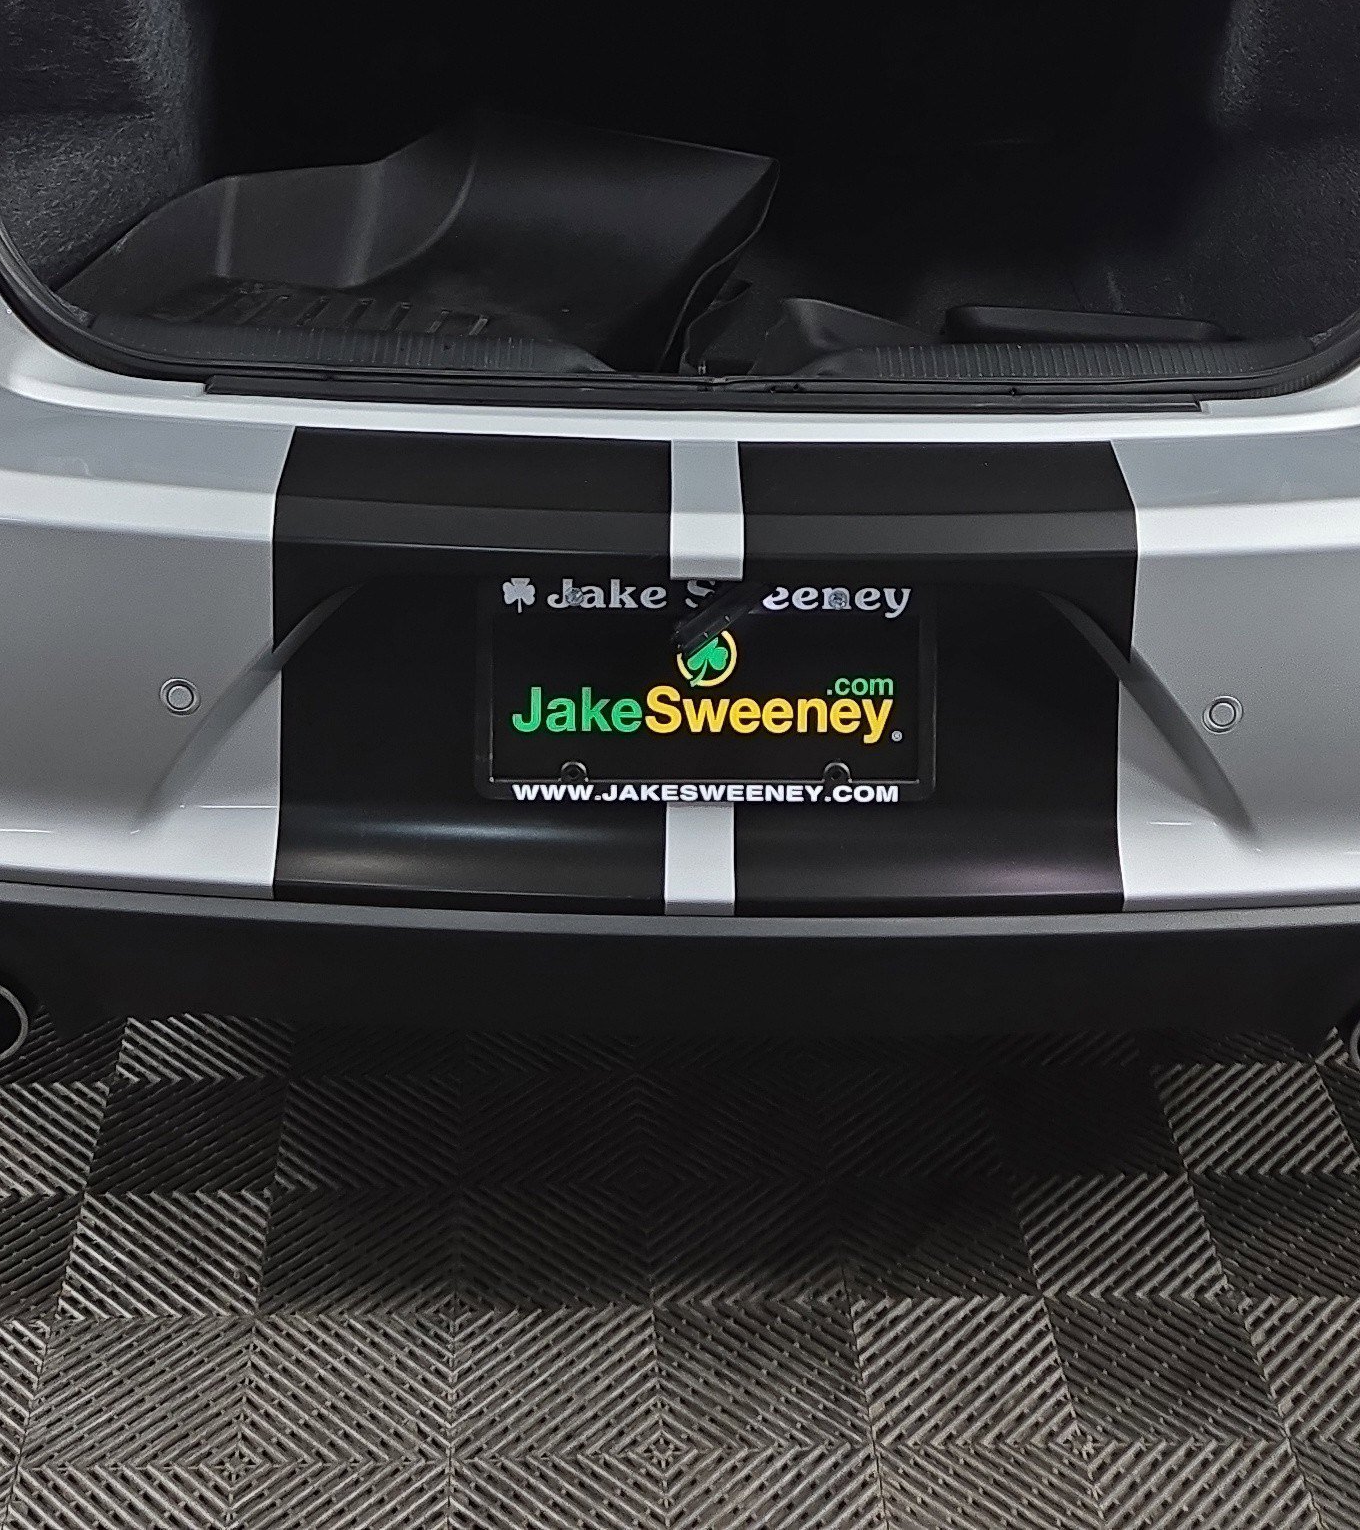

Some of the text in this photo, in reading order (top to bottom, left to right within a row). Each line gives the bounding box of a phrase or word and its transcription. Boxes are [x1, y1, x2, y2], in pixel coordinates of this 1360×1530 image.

[546, 578, 912, 619] Jake Seeney
[826, 674, 895, 697] .com
[512, 784, 900, 803] WWW.JAKESWEENEY.COM
